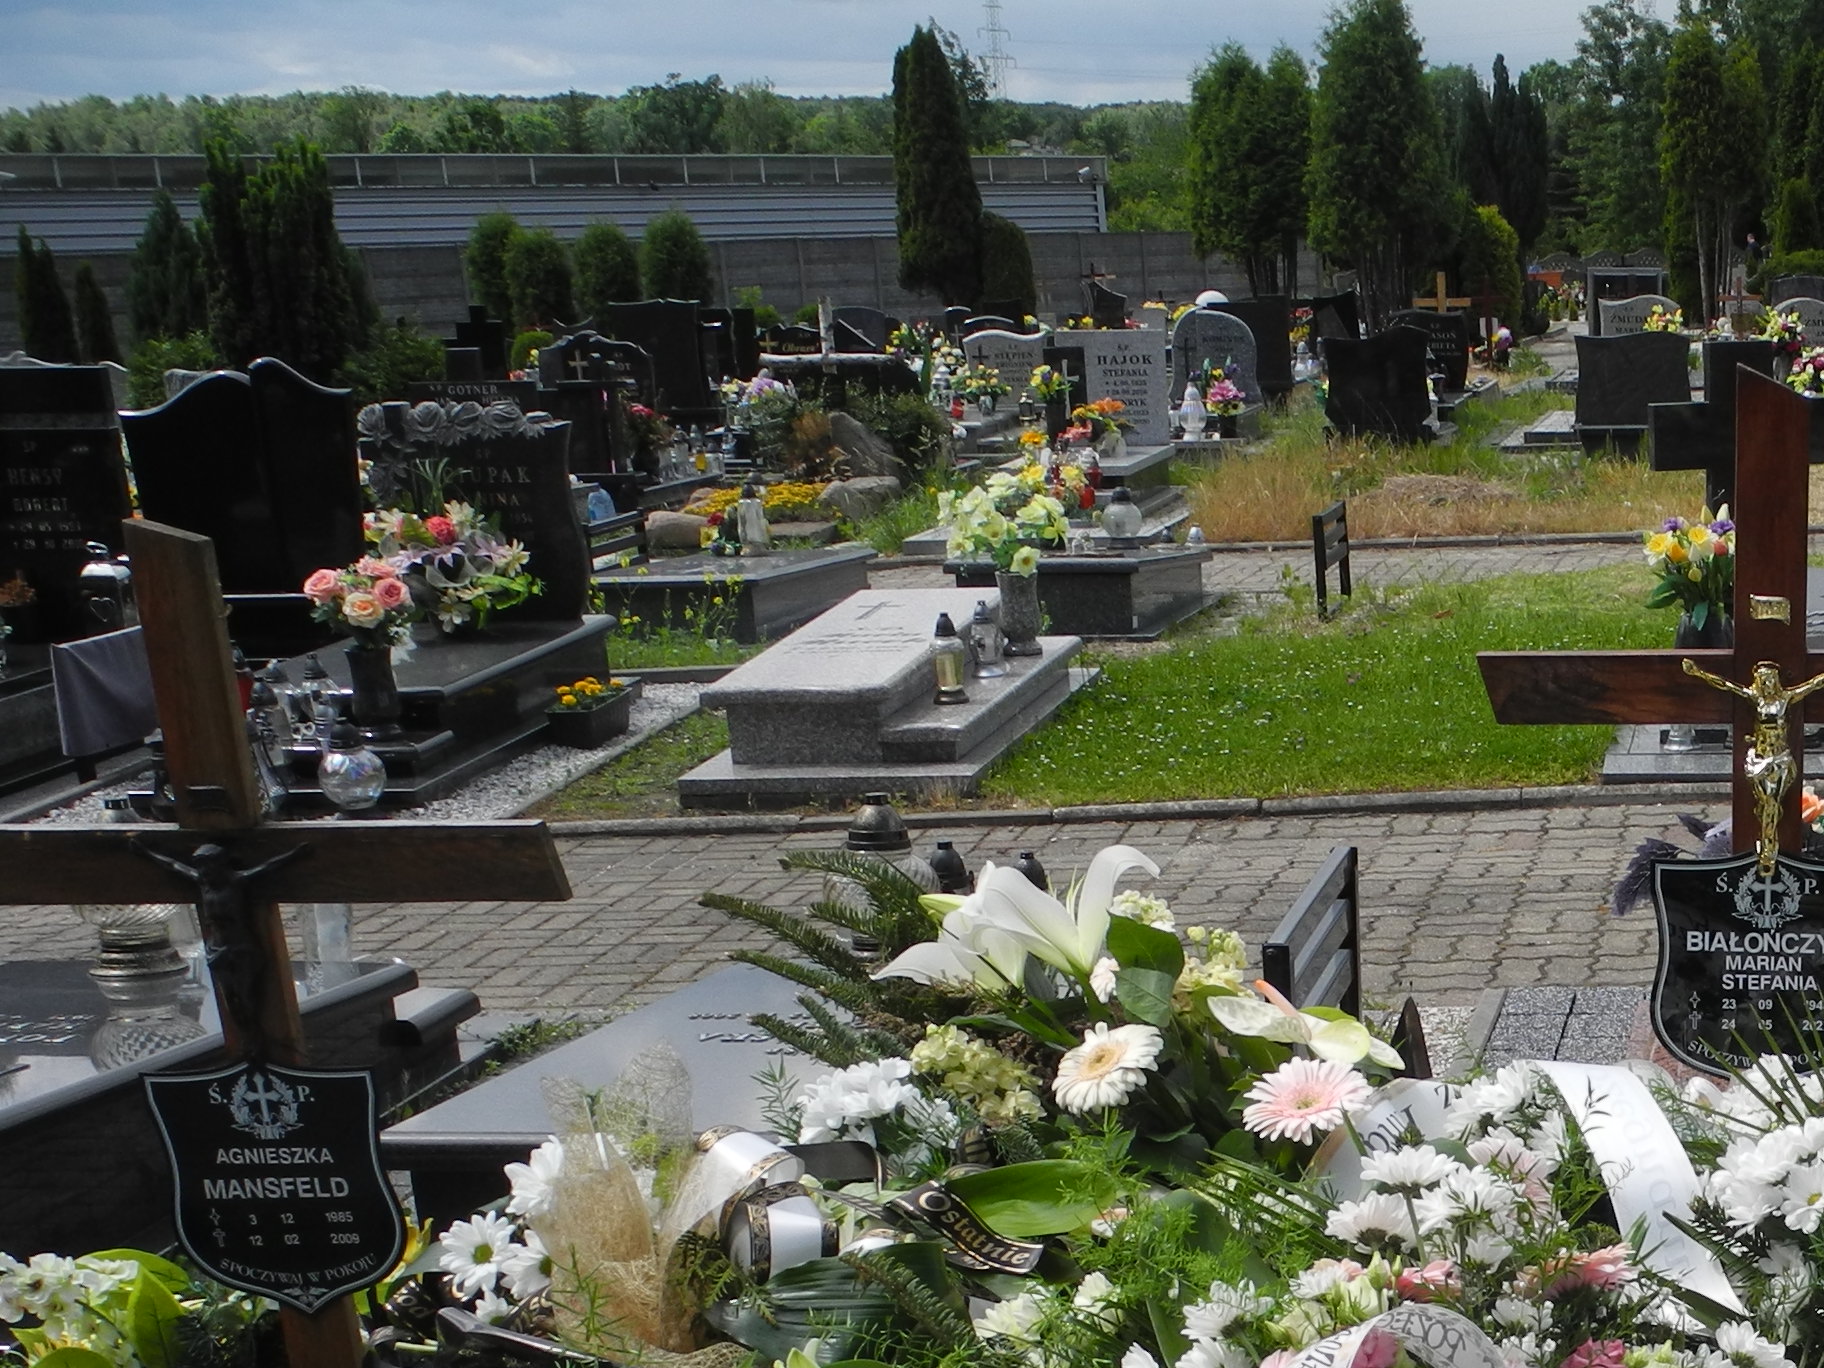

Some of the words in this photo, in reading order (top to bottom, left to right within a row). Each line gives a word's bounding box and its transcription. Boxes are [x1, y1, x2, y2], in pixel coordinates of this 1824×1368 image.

[1097, 354, 1152, 366] HAJOK
[1103, 369, 1149, 377] STEFANIA
[447, 384, 498, 395] GOTNER
[1716, 871, 1733, 893] Ś.
[1804, 878, 1820, 895] P.
[1725, 955, 1802, 972] MARIAN
[1721, 974, 1818, 991] STEFANIA
[1721, 998, 1737, 1010] 23
[1758, 998, 1773, 1010] 09
[1721, 1018, 1736, 1031] 24
[209, 1082, 228, 1104] Ś.
[297, 1085, 315, 1102] P.
[216, 1147, 334, 1164] AGNIESZKA
[203, 1177, 350, 1200] MANSFELD
[249, 1214, 258, 1225] 3
[280, 1213, 295, 1224] 12
[325, 1211, 354, 1223] 1985
[919, 1190, 1031, 1266] Ostatnie
[249, 1235, 264, 1246] 12
[284, 1233, 300, 1245] 02
[330, 1233, 361, 1245] 2009
[219, 1256, 304, 1285] SPOCZYWAJ
[307, 1271, 321, 1283] W
[325, 1252, 378, 1281] POKOJU
